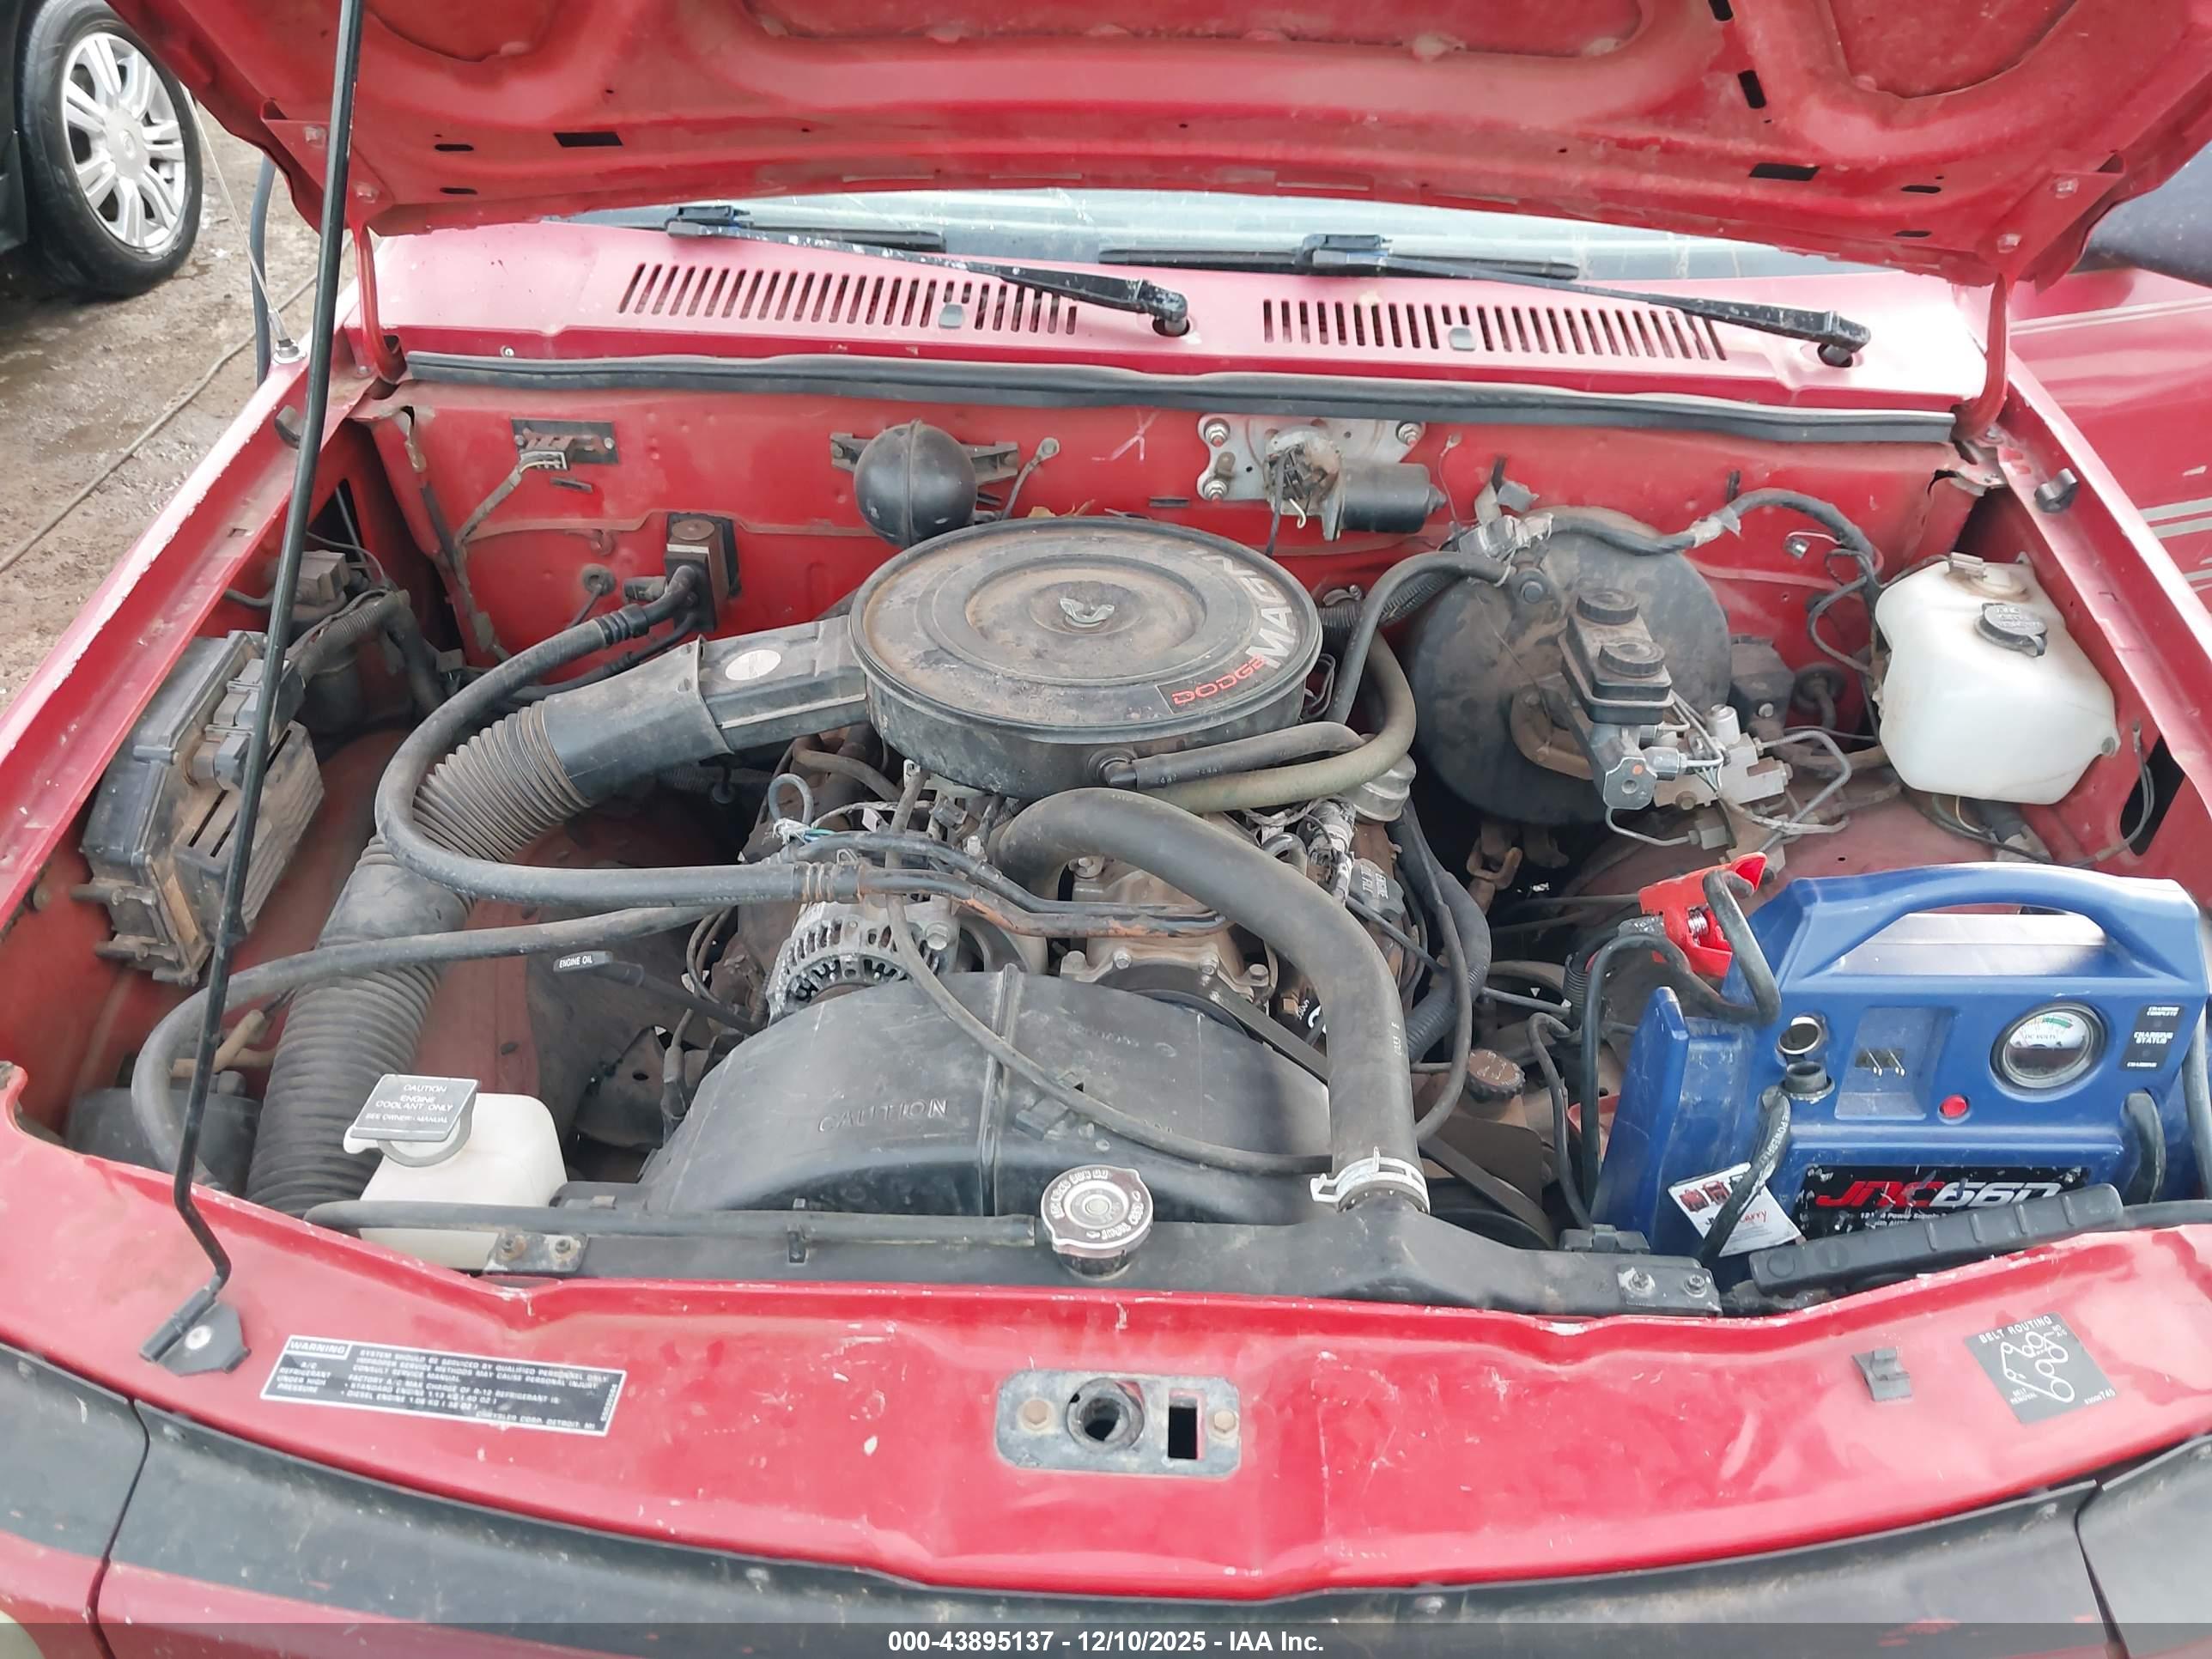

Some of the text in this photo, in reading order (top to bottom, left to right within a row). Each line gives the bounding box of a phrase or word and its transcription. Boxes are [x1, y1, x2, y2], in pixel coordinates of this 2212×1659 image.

[1171, 653, 1266, 705] DODGE
[559, 955, 592, 969] ENGINE OIL
[404, 1084, 447, 1092] CAUTION
[375, 1100, 453, 1112] COOLANT ONLY
[818, 1099, 948, 1133] CAUTION
[1978, 1315, 2052, 1344] BELT ROUTING
[289, 1341, 345, 1354] WARNING
[358, 1349, 392, 1358] SYSTEM
[441, 1358, 479, 1368] SERVICED
[494, 1364, 536, 1375] QUALIFIED
[347, 1374, 384, 1383] FACTORY
[493, 1390, 549, 1402] REFRIGERANT
[495, 1372, 523, 1382] CAUSE
[524, 1376, 566, 1386] PERSONAL
